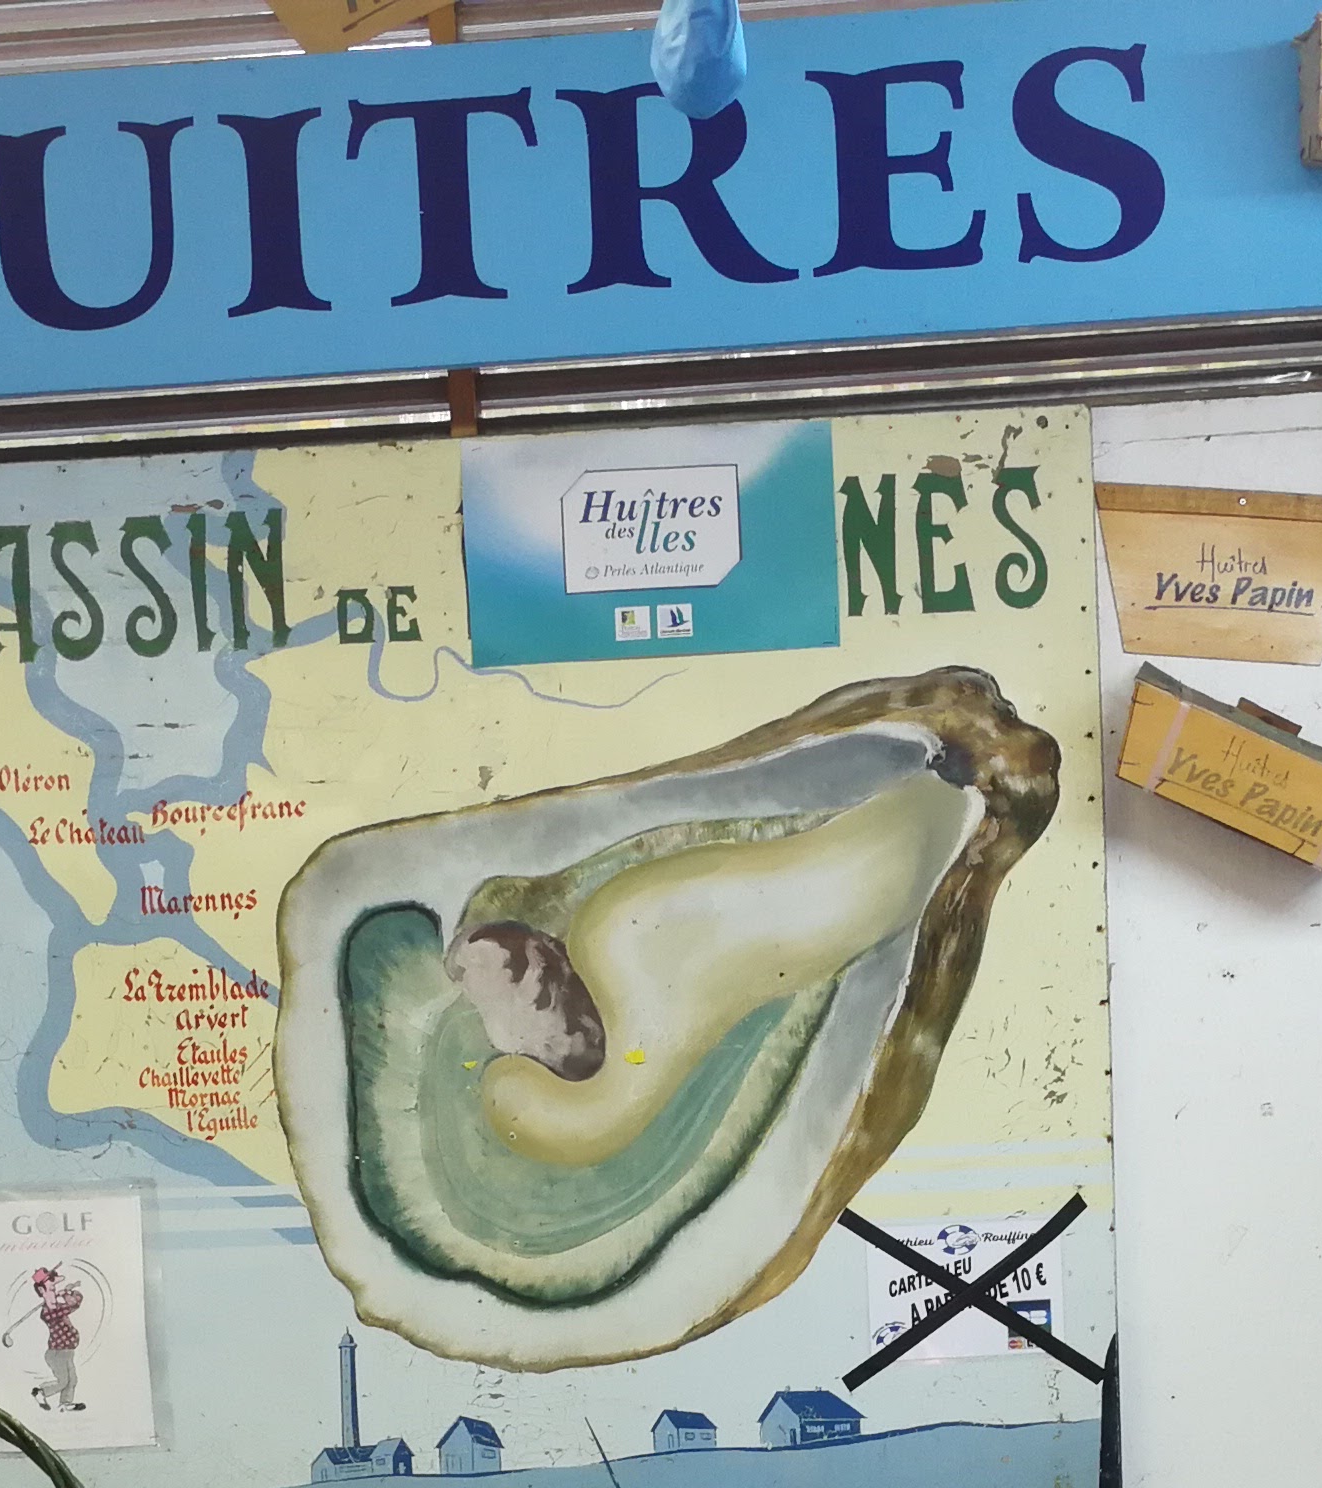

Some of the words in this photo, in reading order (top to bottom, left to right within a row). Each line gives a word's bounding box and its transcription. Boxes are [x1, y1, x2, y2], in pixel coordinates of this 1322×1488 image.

[579, 488, 723, 525] Huîtres
[604, 522, 635, 540] des
[603, 563, 637, 578] Perles
[640, 561, 705, 576] Atlantique
[1154, 572, 1222, 605] Yves
[1230, 576, 1315, 613] Papin
[335, 585, 423, 645] DE
[1167, 746, 1236, 799] Yves
[140, 885, 258, 920] Marennes
[123, 967, 147, 1003] La
[147, 966, 270, 1003] Tremblade
[138, 1065, 240, 1089] Chaillevette
[167, 1088, 241, 1109] Mornac
[11, 1211, 93, 1236] GOLF
[1012, 1268, 1032, 1295] 10
[1035, 1262, 1047, 1286] €
